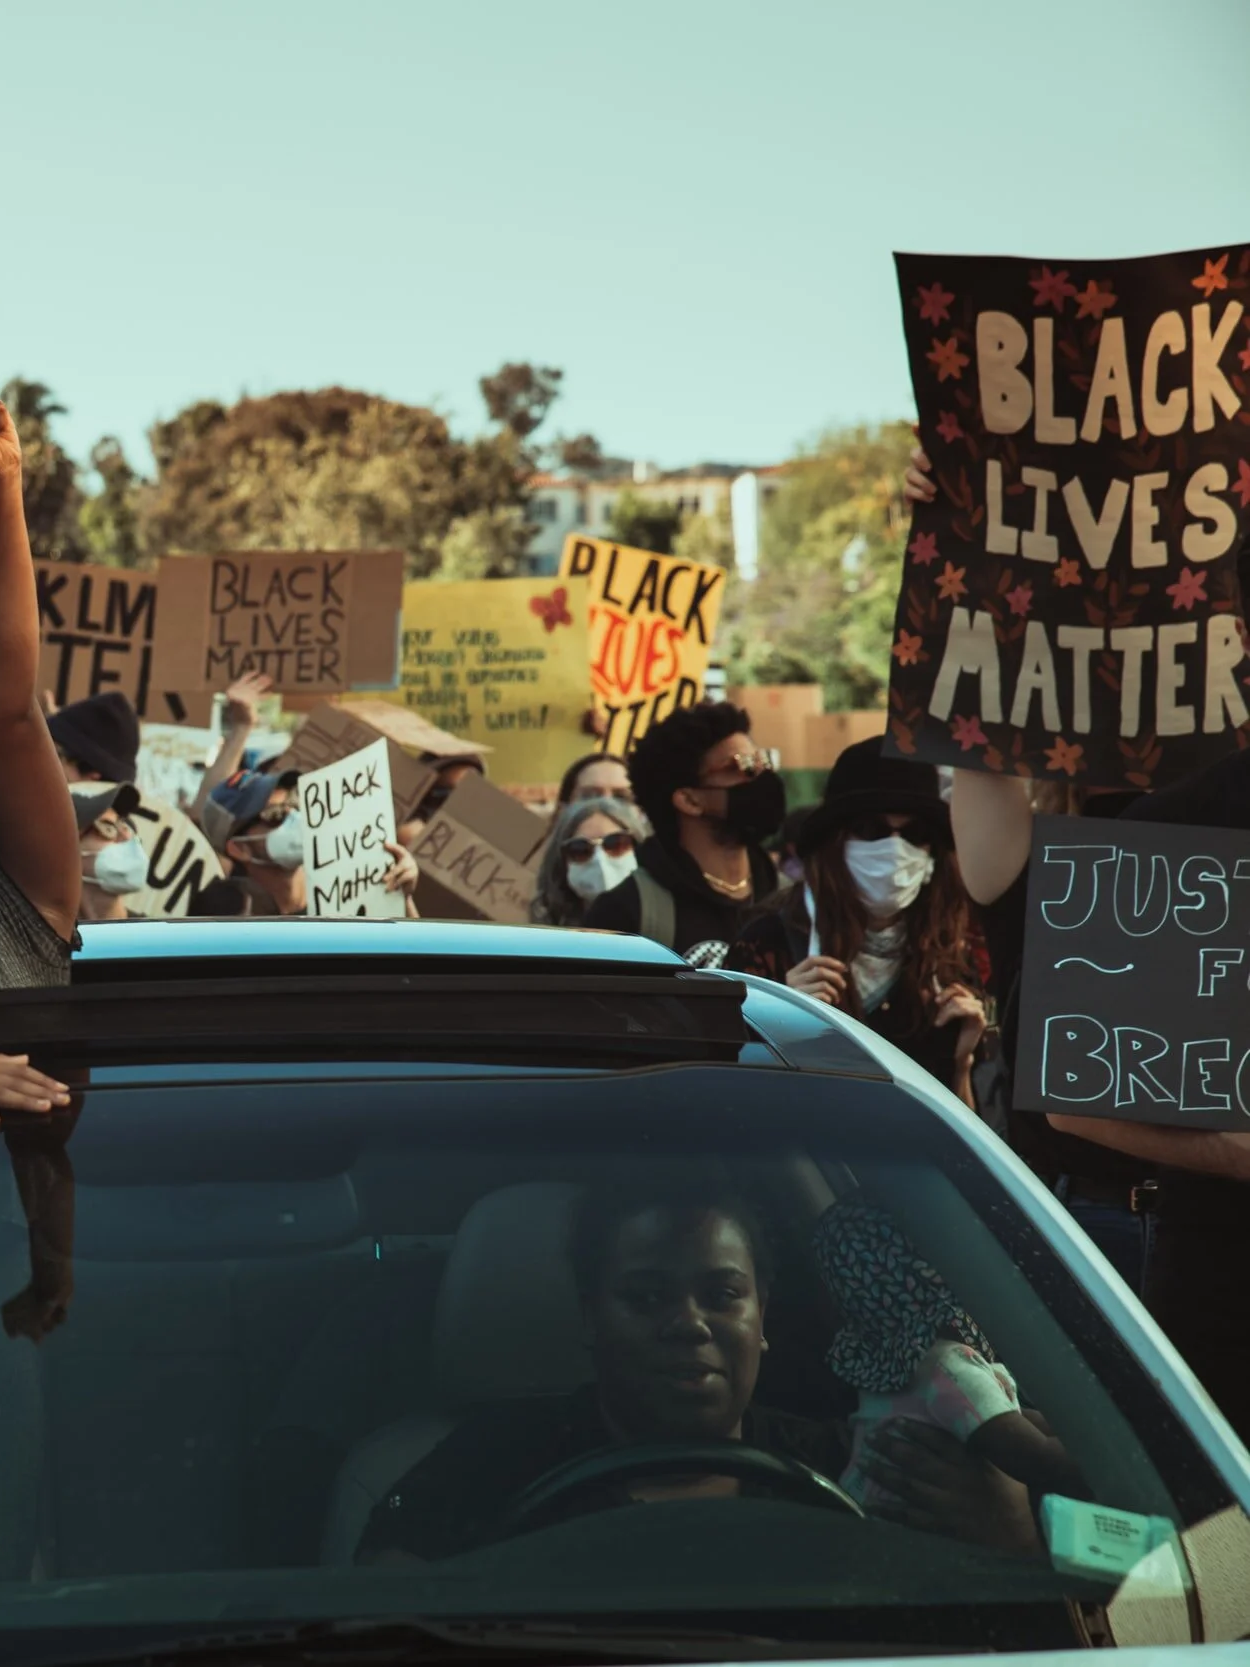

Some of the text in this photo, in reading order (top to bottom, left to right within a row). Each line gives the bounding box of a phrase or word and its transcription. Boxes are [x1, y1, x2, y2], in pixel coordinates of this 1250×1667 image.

[976, 300, 1243, 445] BLACK
[986, 460, 1237, 569] LIVES
[210, 559, 347, 615] BLACK
[218, 608, 345, 647] LIVES
[206, 646, 341, 685] MATTER
[590, 607, 684, 695] IVES
[928, 606, 1249, 737] MATTER
[304, 759, 381, 829] BLACK
[313, 813, 387, 870] Lives
[416, 820, 515, 904] BLACK
[1042, 845, 1250, 936] JUS
[1042, 1014, 1250, 1117] BRE
